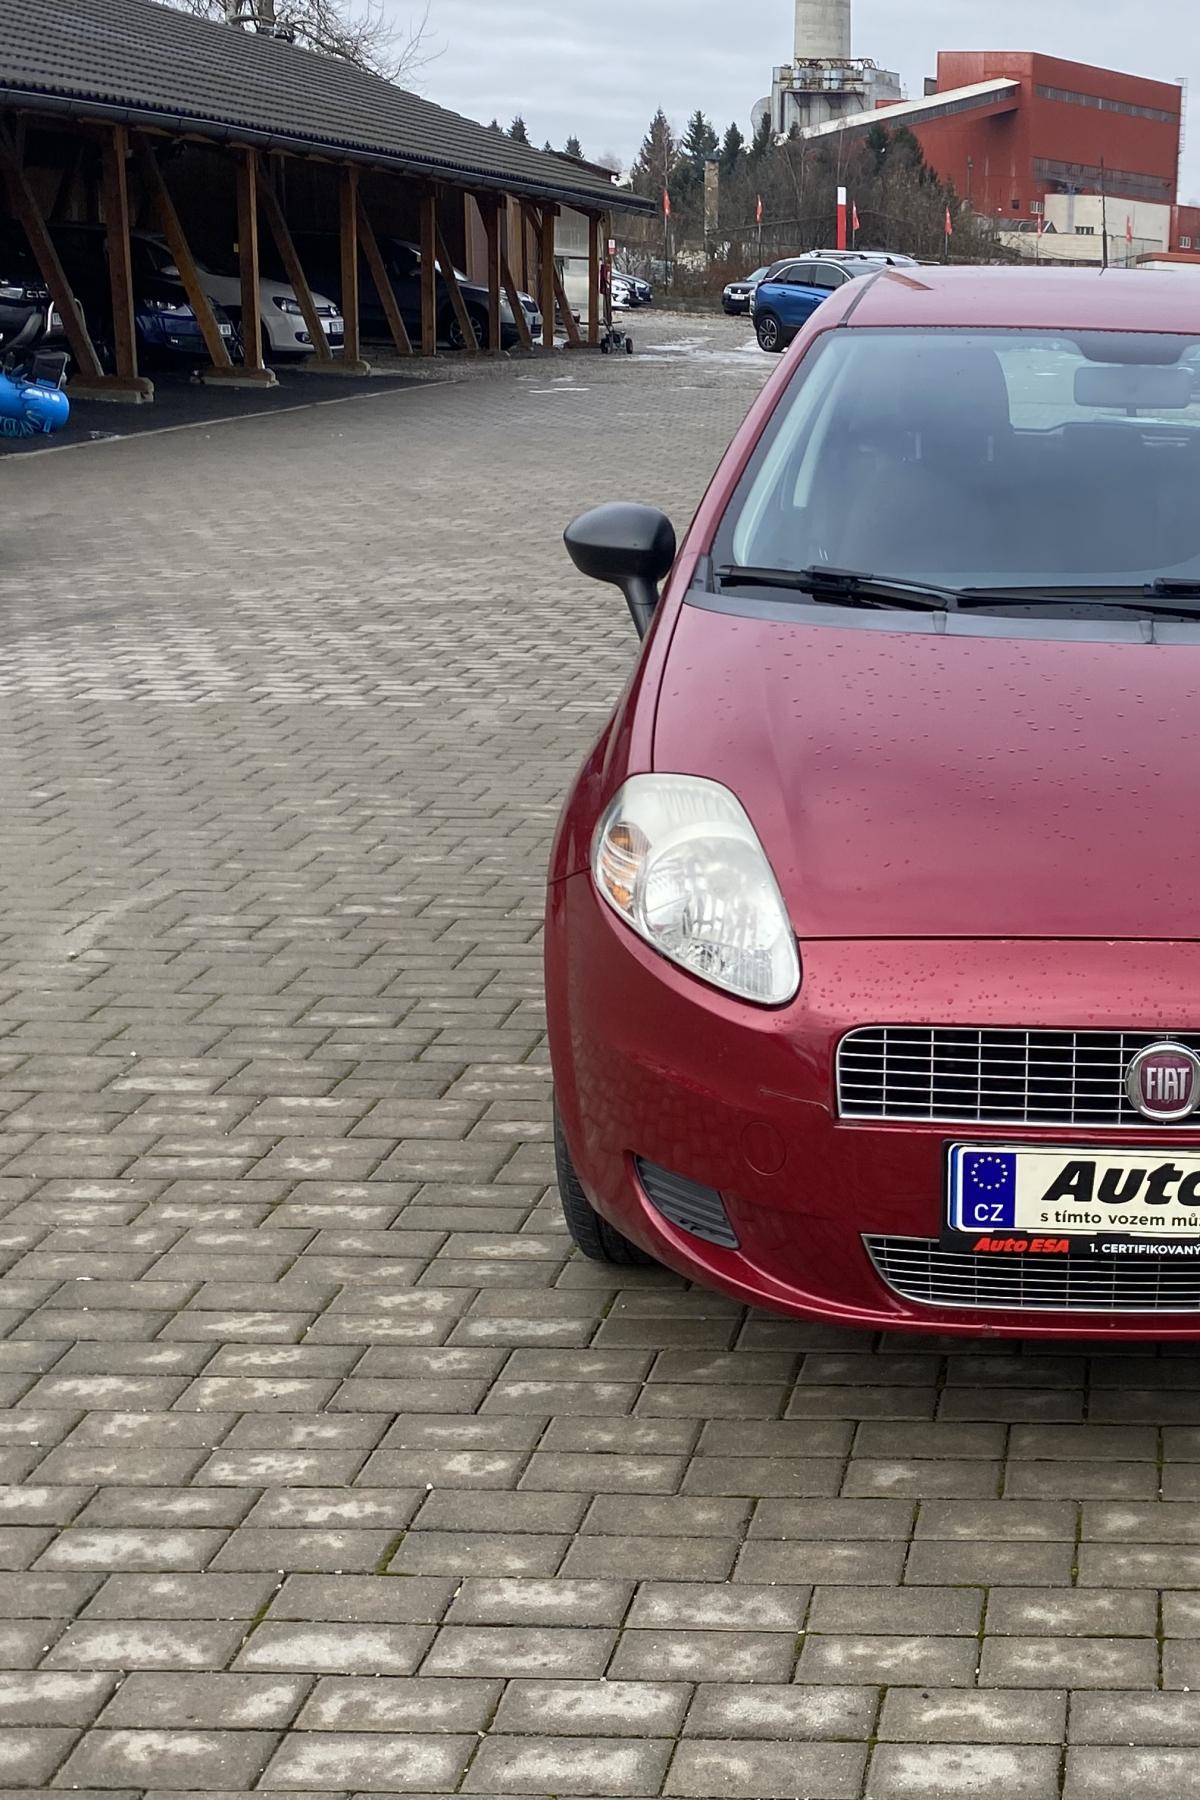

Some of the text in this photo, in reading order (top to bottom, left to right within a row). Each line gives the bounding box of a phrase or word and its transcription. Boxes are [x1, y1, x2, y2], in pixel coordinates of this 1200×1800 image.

[1146, 1066, 1190, 1100] FIAT
[974, 1203, 1004, 1222] CZ
[1040, 1212, 1049, 1222] s
[1055, 1210, 1102, 1224] tímto
[1108, 1214, 1165, 1226] vozem
[973, 1237, 1069, 1253] Auto ESA
[1089, 1243, 1099, 1253] 1.
[1101, 1243, 1200, 1256] CERTIFIKOVANÝ
